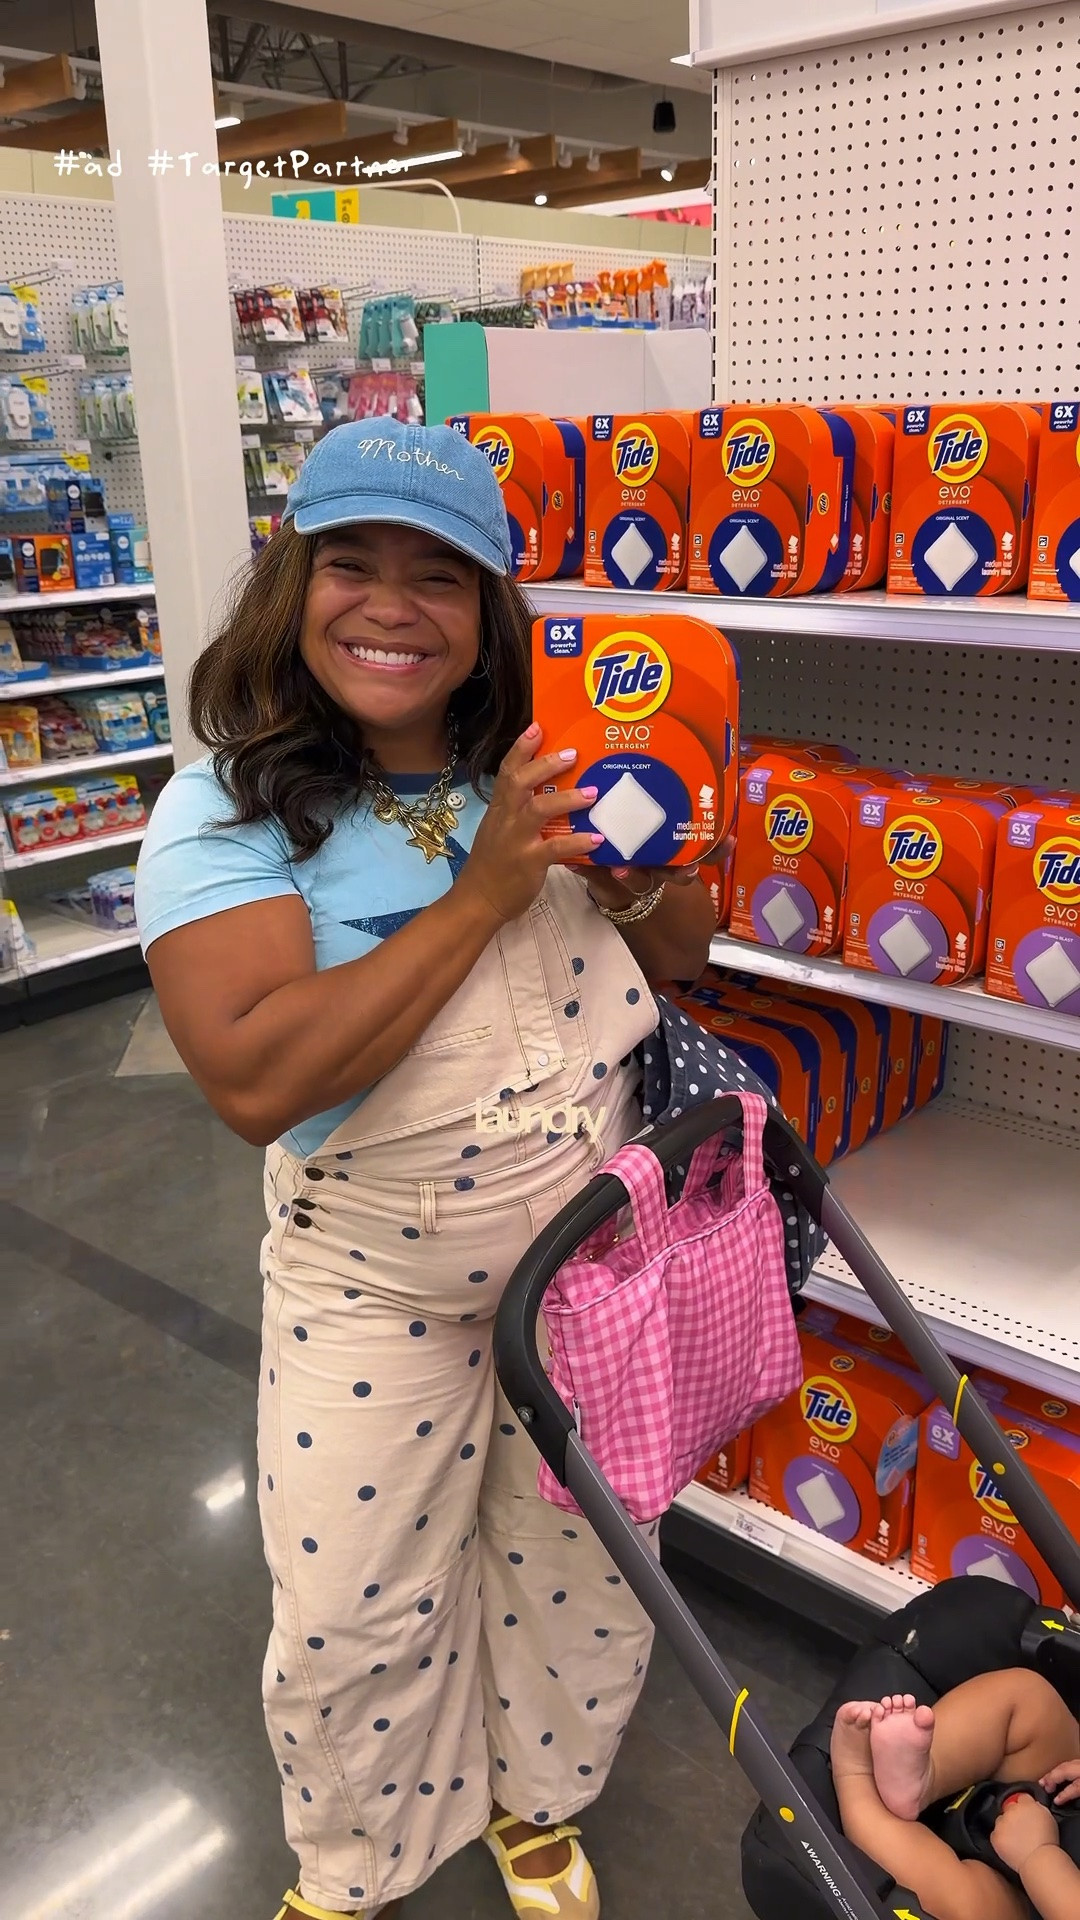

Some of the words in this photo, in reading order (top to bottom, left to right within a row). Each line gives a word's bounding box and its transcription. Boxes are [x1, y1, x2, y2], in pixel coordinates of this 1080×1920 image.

[702, 414, 719, 426] 6X
[906, 410, 926, 423] 6X
[1054, 405, 1075, 419] 6X
[595, 418, 609, 430] 6X
[357, 438, 465, 481] Mother
[615, 437, 655, 477] Tide
[725, 432, 771, 476] Tide
[931, 429, 983, 474] Tide
[550, 624, 576, 641] 6X
[592, 651, 663, 709] Tide
[604, 725, 651, 741] evo
[748, 782, 764, 795] 6X
[702, 811, 714, 820] 16
[863, 803, 882, 817] 6X
[676, 821, 699, 831] medium
[700, 821, 715, 830] load
[767, 807, 810, 843] Tide
[1011, 822, 1032, 837] 6X
[673, 831, 698, 842] laundry
[699, 831, 715, 841] tiles
[886, 828, 938, 866] Tide
[805, 1387, 852, 1429] Tide
[930, 1424, 955, 1446] 6X
[808, 1435, 841, 1458] evo
[980, 1514, 1017, 1540] evo
[806, 1847, 842, 1898] WARNING
